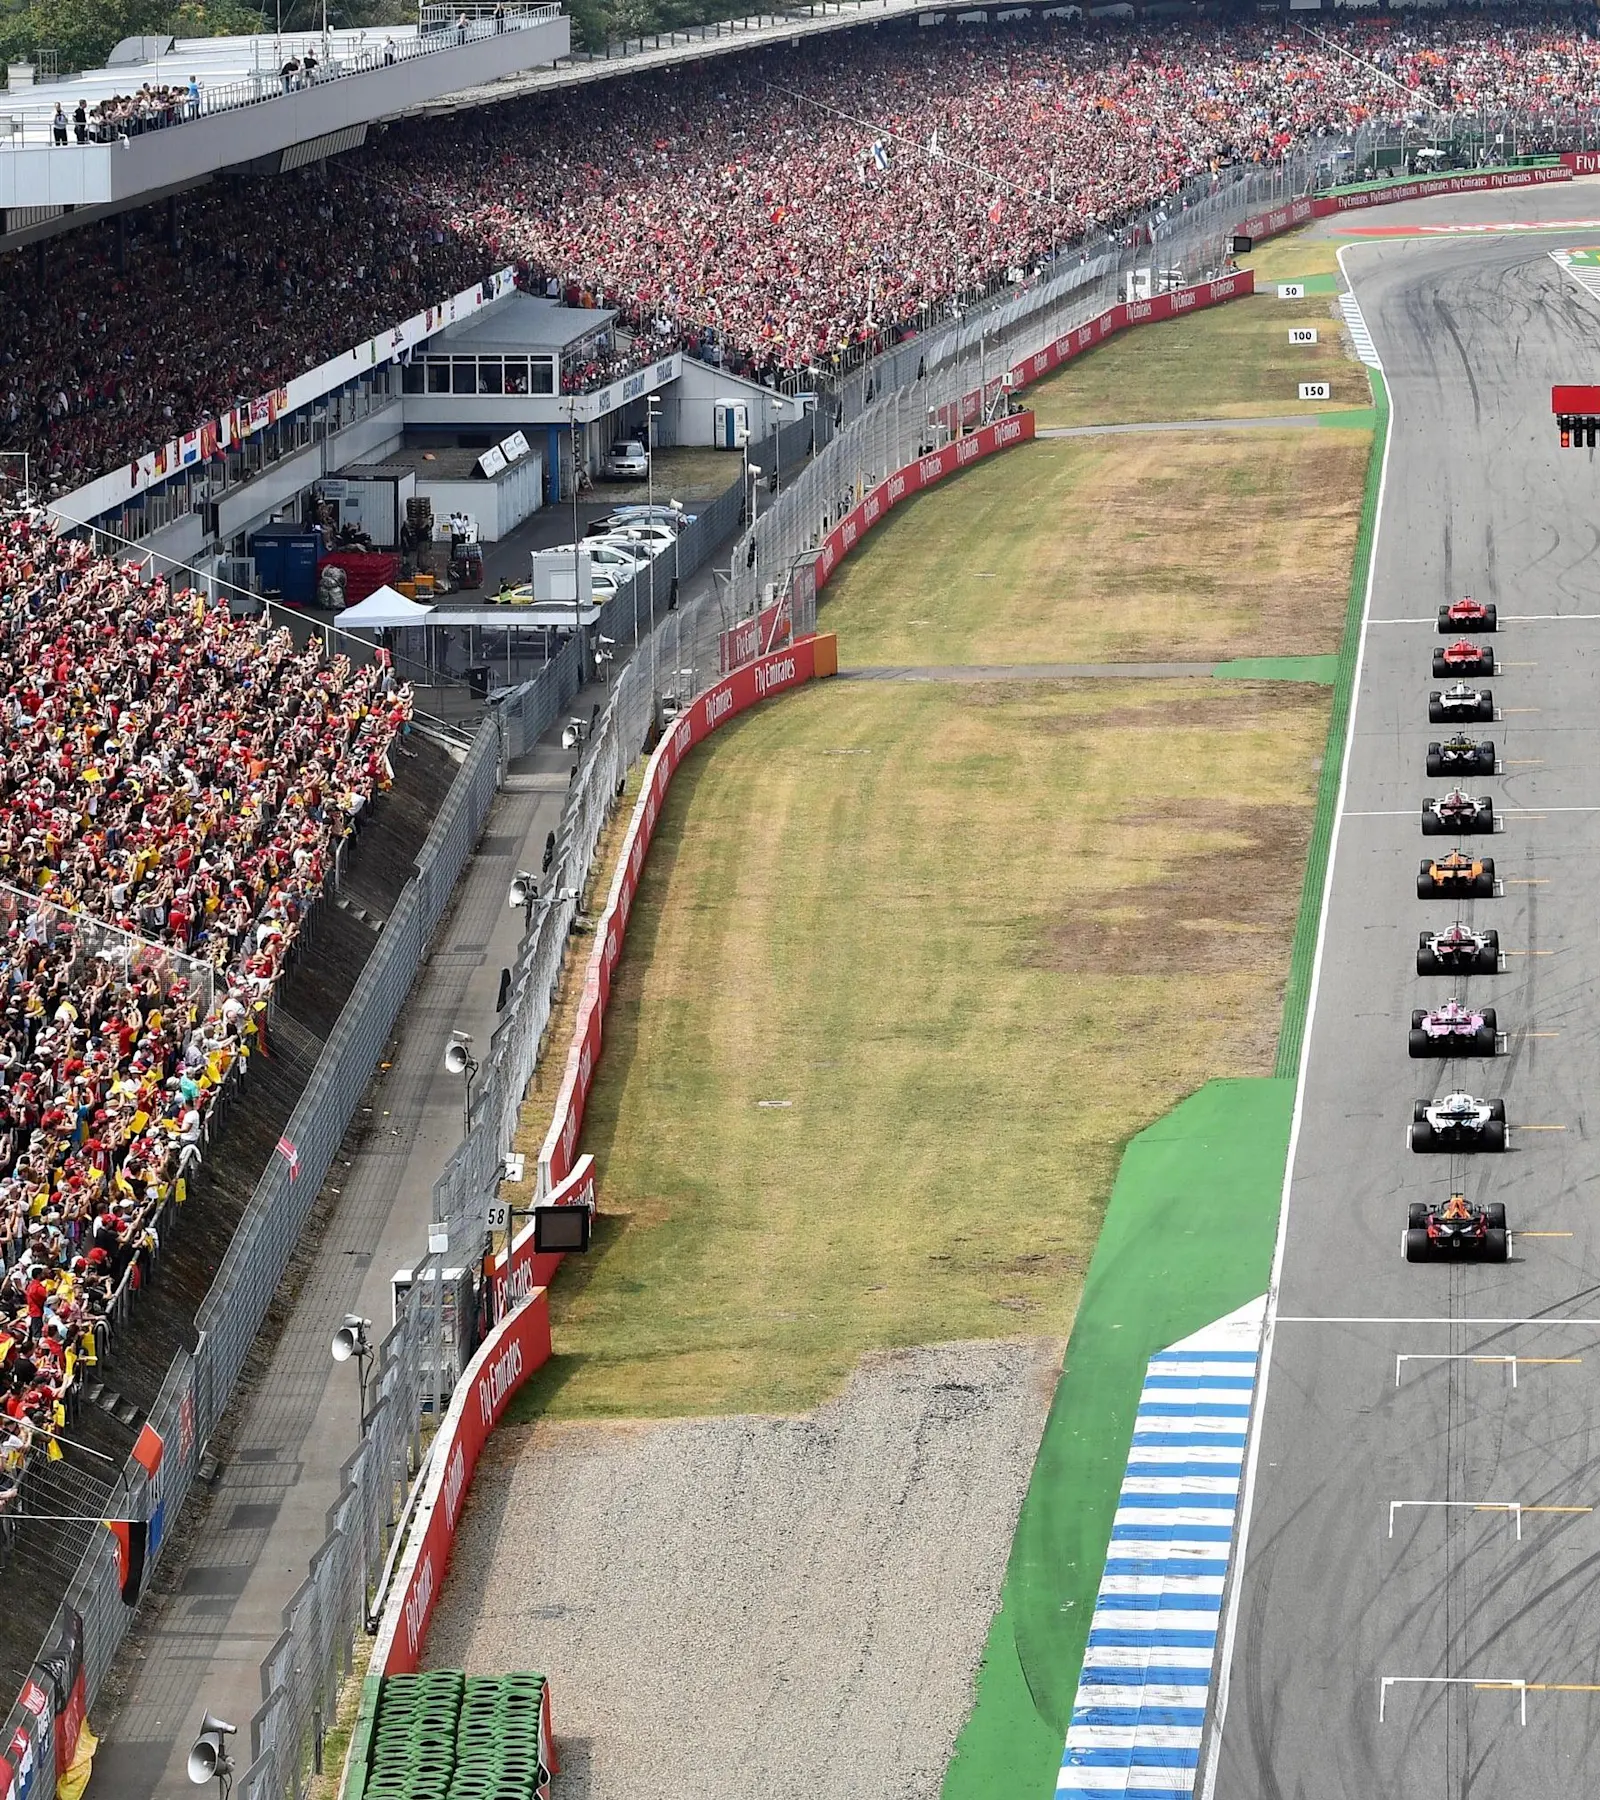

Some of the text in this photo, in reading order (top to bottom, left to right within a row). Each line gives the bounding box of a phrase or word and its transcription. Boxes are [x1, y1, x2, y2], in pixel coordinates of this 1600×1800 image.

[1576, 154, 1597, 170] Fly
[1285, 287, 1297, 296] 50
[1293, 331, 1312, 341] 100
[1304, 386, 1324, 396] 150
[755, 656, 796, 696] Fly Emirates
[706, 685, 733, 728] Fly Emirates
[488, 1208, 505, 1225] 58
[479, 1337, 522, 1427] Fly Emirates
